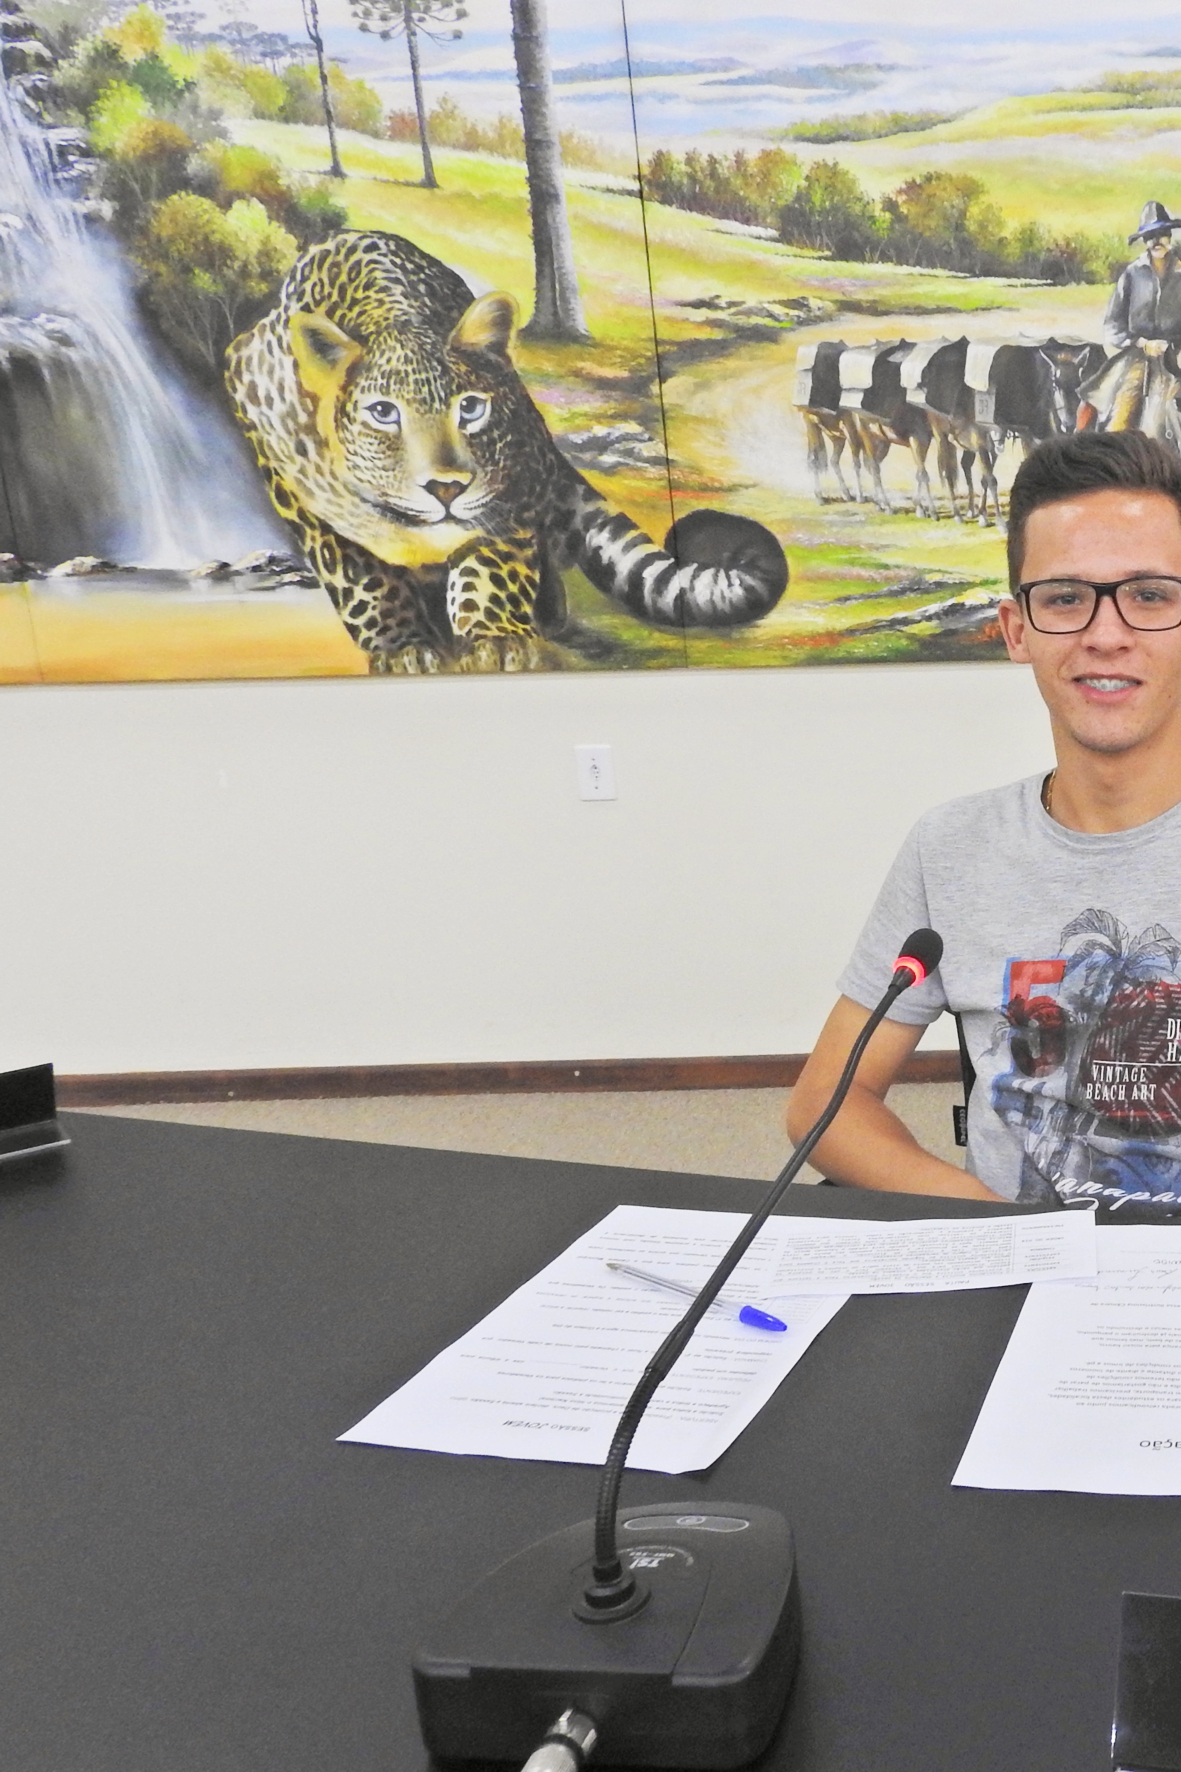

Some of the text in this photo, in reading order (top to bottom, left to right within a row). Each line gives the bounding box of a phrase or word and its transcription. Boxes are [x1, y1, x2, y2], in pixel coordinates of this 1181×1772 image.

[1092, 1064, 1146, 1083] VINTAGE
[1085, 1083, 1157, 1101] BEACH ART
